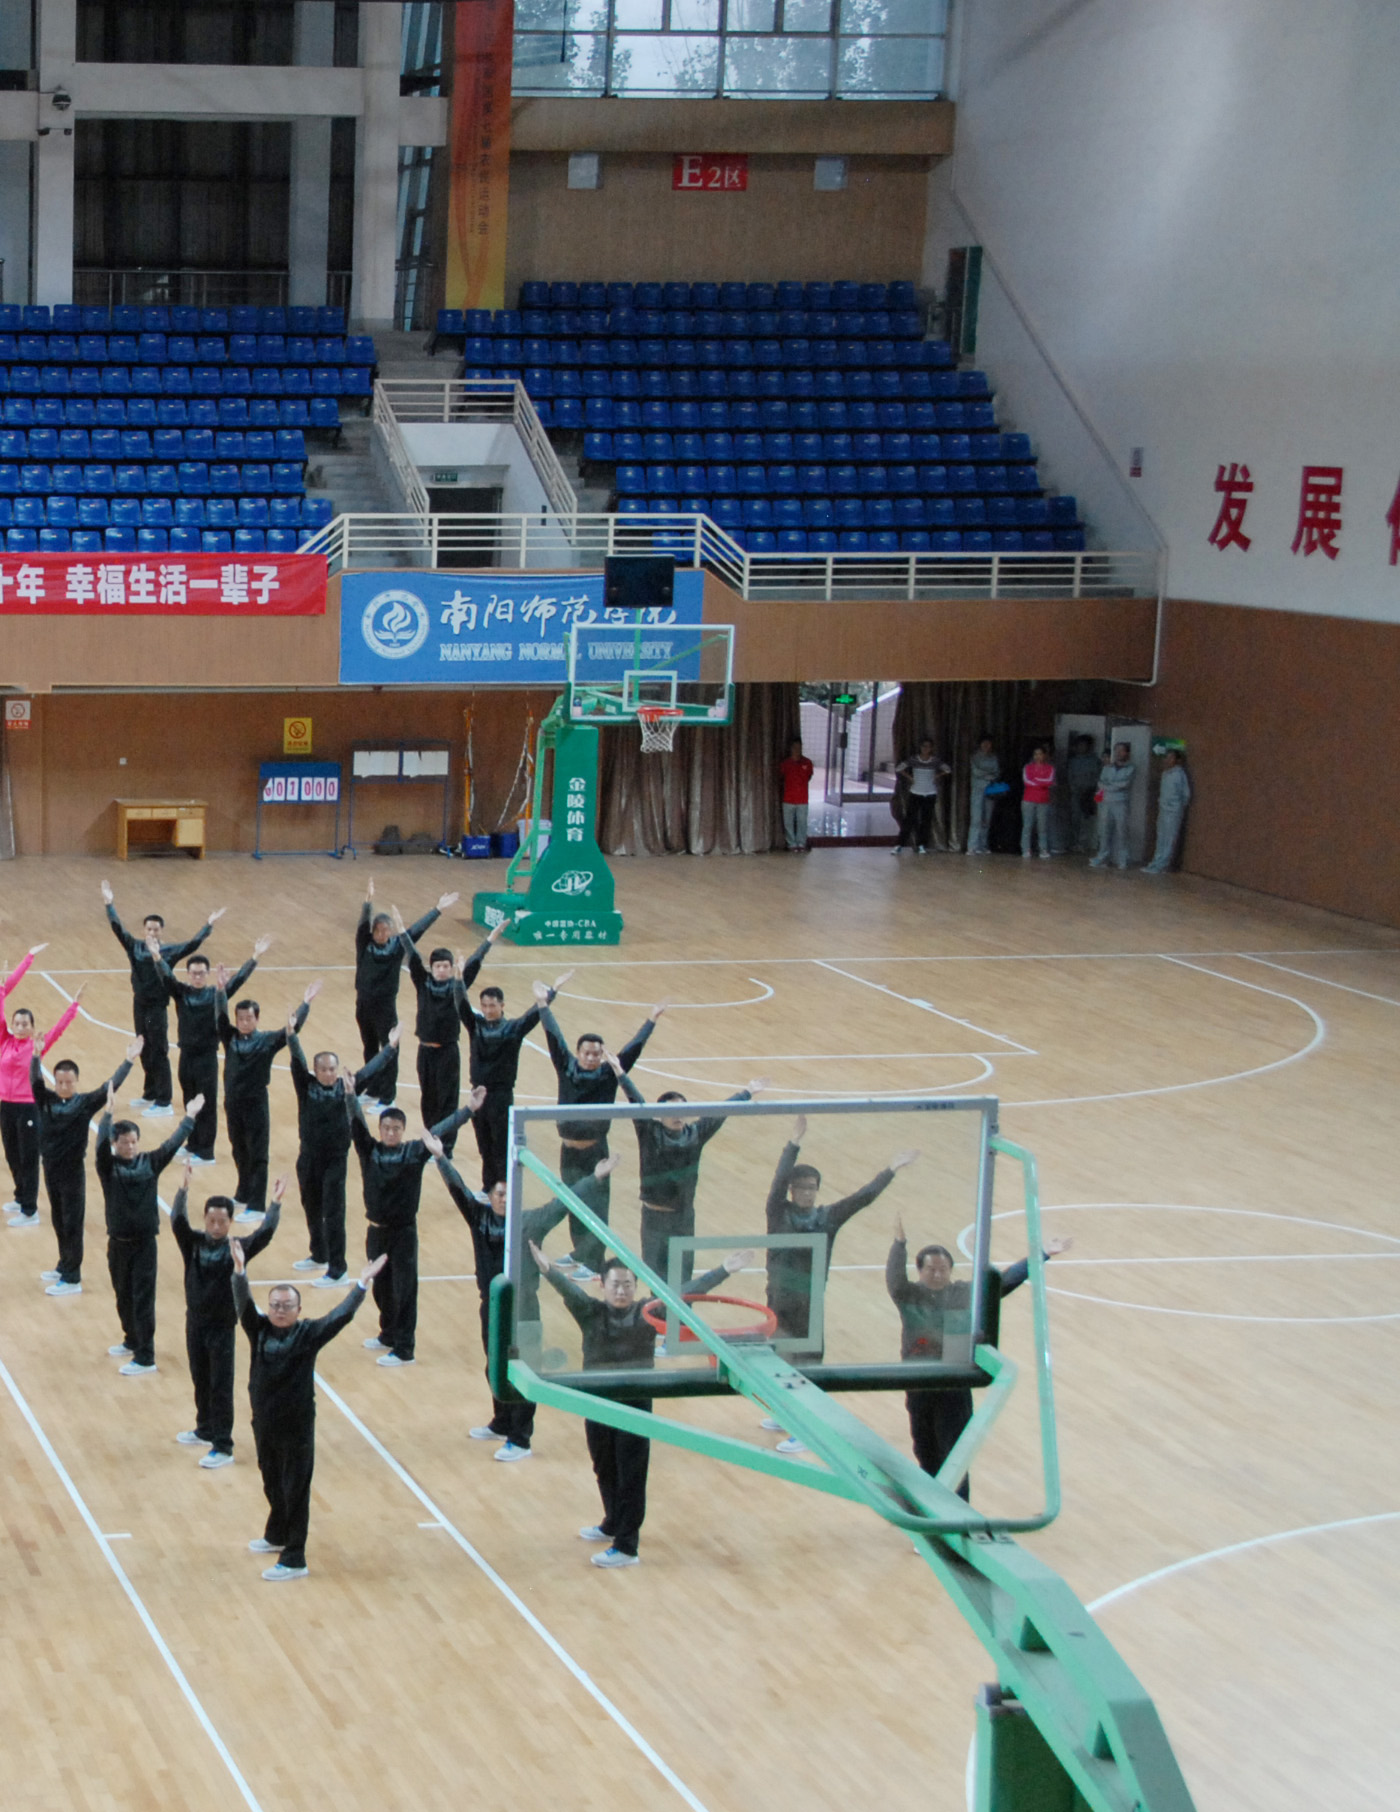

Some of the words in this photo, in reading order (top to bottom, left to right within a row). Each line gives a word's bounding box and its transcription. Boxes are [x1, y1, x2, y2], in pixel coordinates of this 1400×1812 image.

[677, 155, 741, 188] E2区
[65, 563, 280, 605] 幸福生活一辈子
[439, 642, 513, 661] NANYANG
[518, 642, 582, 661] NORM
[587, 641, 673, 660] UNIVESITY
